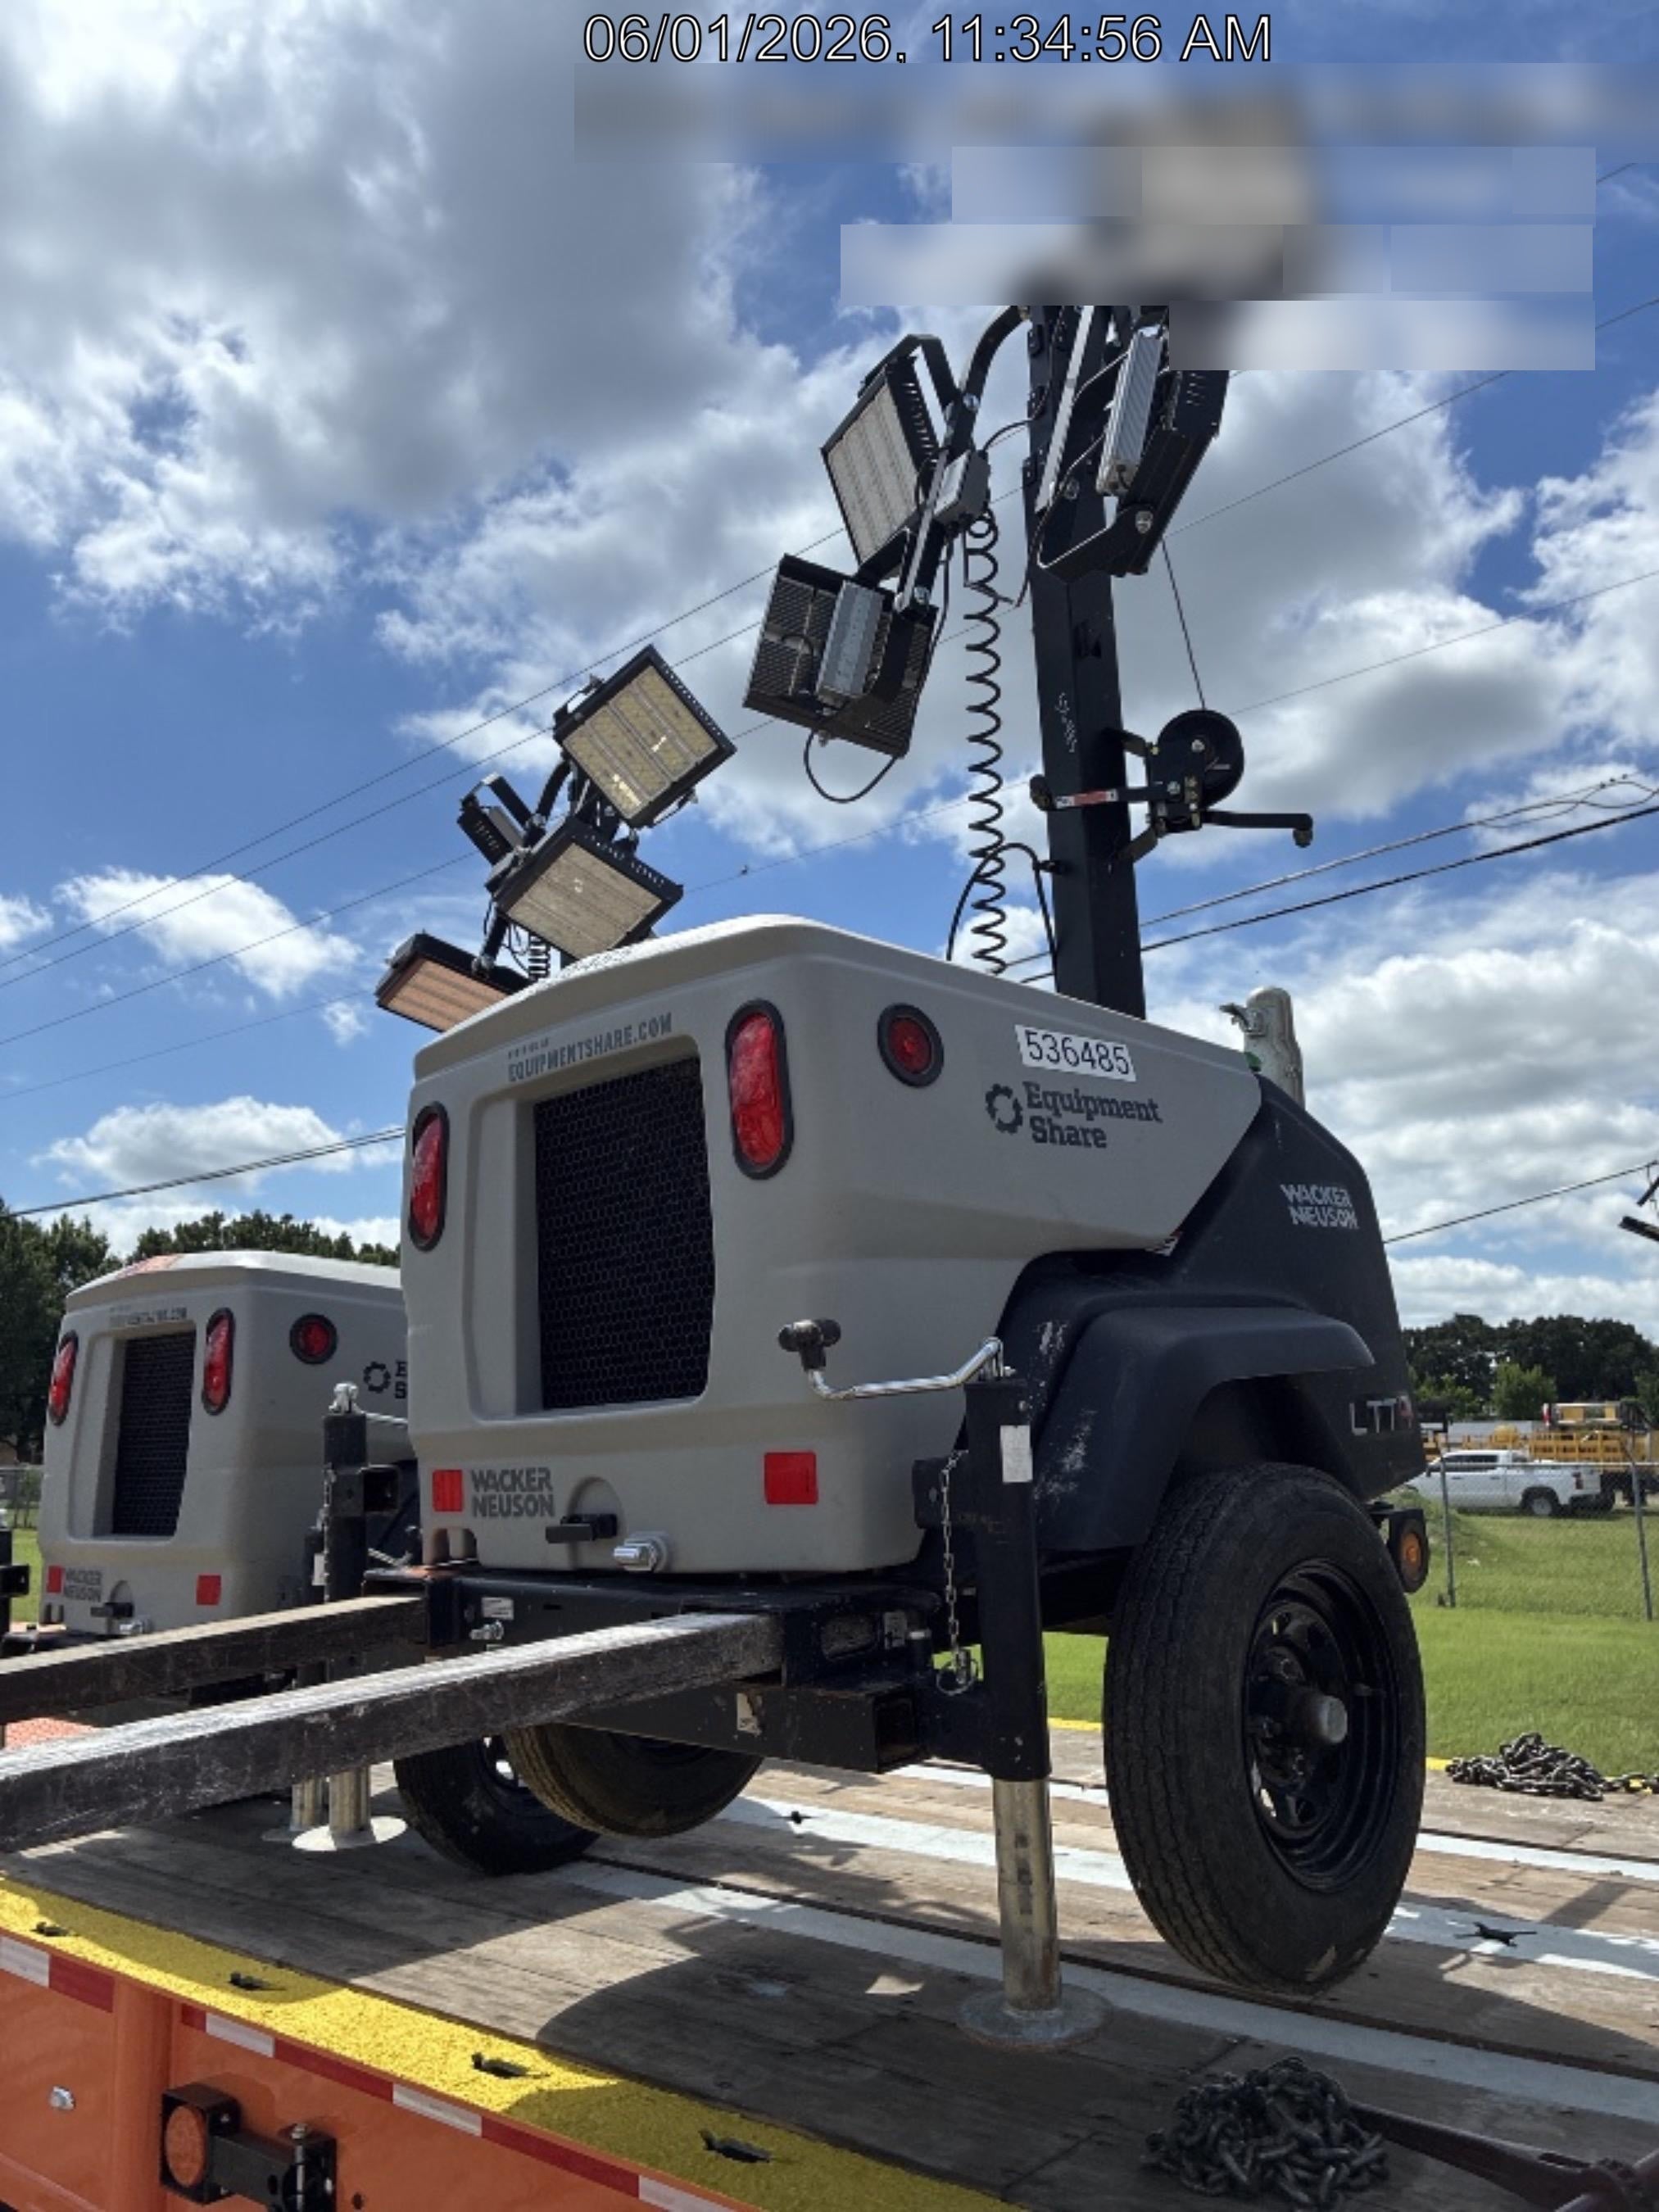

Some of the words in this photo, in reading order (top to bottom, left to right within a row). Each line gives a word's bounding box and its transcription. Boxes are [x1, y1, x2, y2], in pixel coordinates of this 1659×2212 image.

[507, 1011, 673, 1082] EQUIPMENTSHARE.COM
[1024, 1029, 1130, 1075] 536485
[1022, 1080, 1163, 1124] Equipment
[1029, 1115, 1108, 1149] Share
[1279, 1184, 1353, 1208] WACKER
[1288, 1205, 1360, 1230] NEUSON
[470, 1467, 553, 1494] WACKER
[472, 1493, 555, 1517] NEUSON
